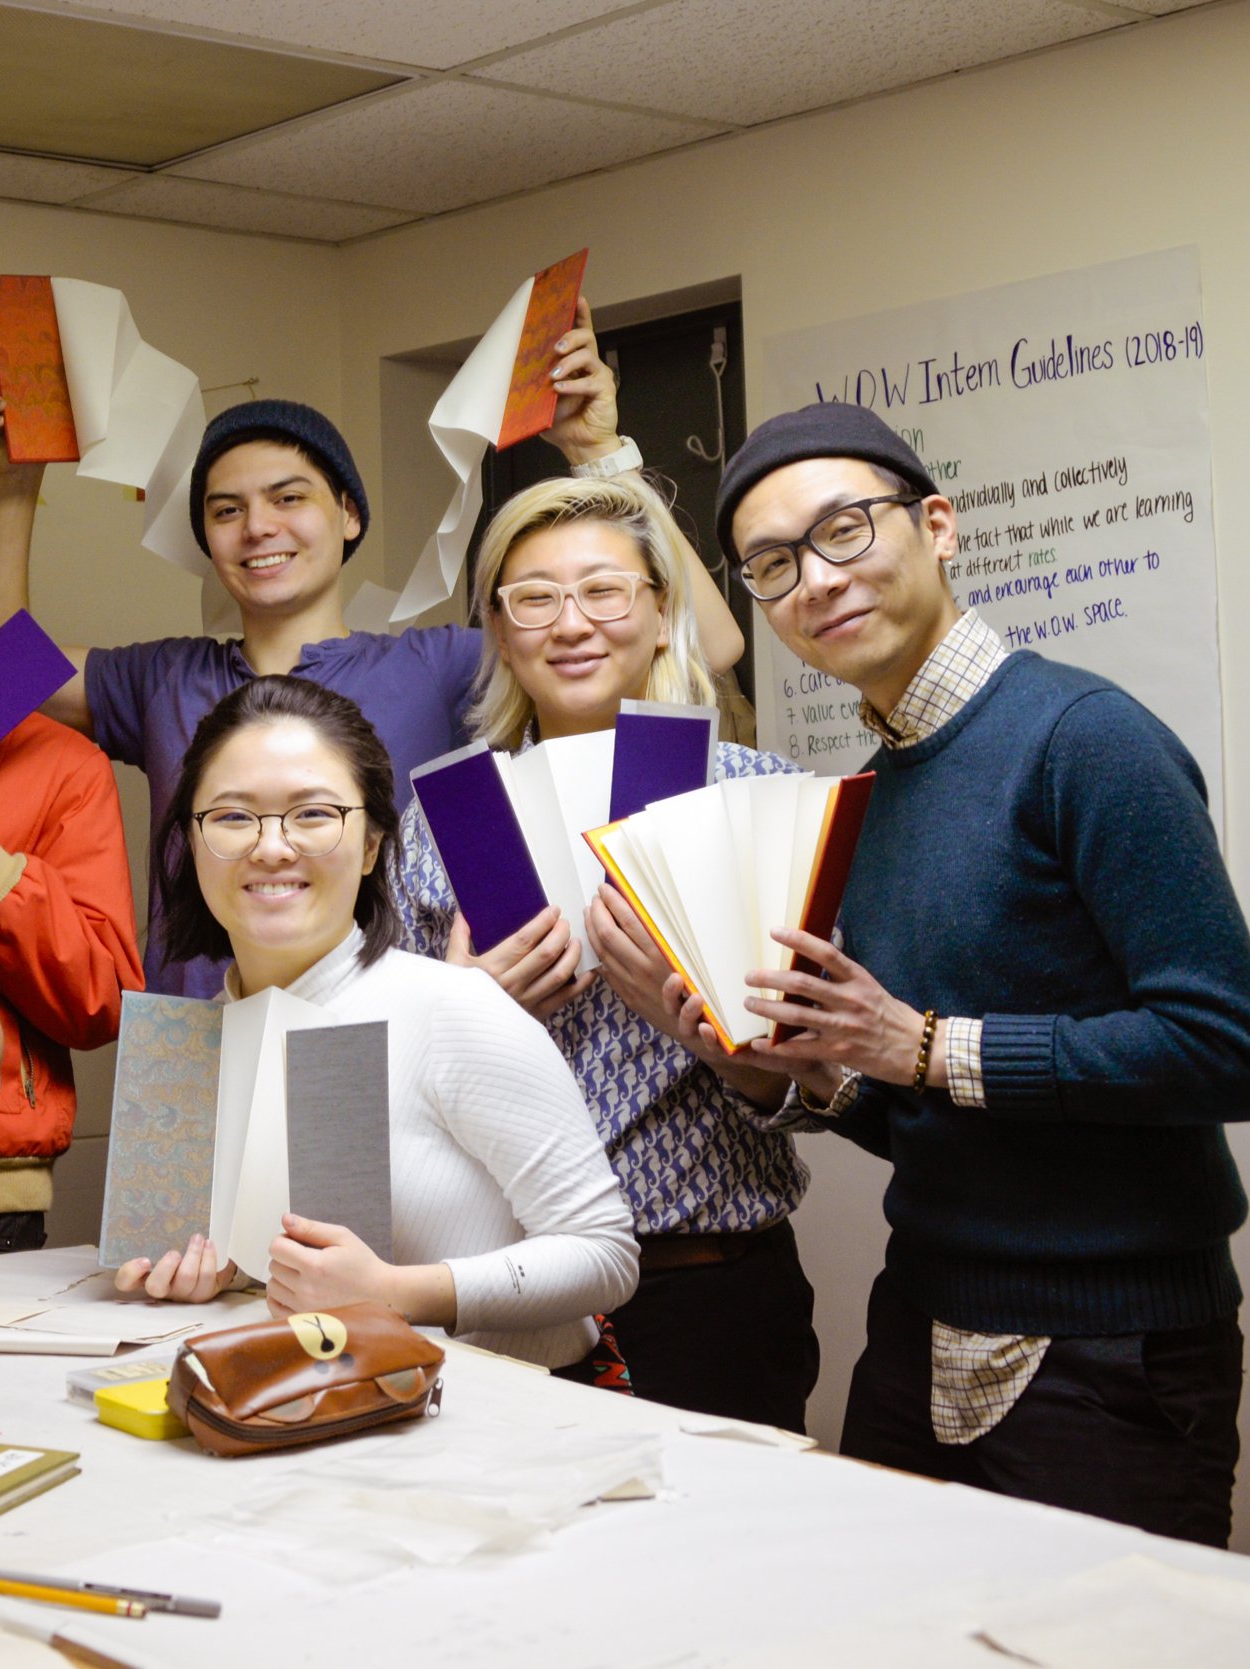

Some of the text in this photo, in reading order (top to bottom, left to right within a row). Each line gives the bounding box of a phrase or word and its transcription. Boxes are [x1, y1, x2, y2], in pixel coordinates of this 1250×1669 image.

[918, 351, 1001, 405] Intern
[1011, 334, 1114, 389] Guidelines
[1125, 321, 1204, 369] (2018-19)
[1022, 471, 1048, 498] and
[1054, 457, 1128, 492] collectively
[974, 526, 1001, 551] fact
[1004, 521, 1034, 545] that
[1040, 515, 1075, 538] while
[1083, 509, 1100, 530] we
[1106, 502, 1128, 525] are
[1136, 490, 1193, 523] learning
[950, 562, 963, 580] at
[966, 550, 1023, 577] different
[968, 584, 992, 607] and
[995, 572, 1060, 599] encourage
[1066, 564, 1093, 584] each
[1099, 557, 1138, 577] other
[1143, 550, 1160, 570] to
[1005, 625, 1033, 648] the
[808, 732, 851, 756] Respect
